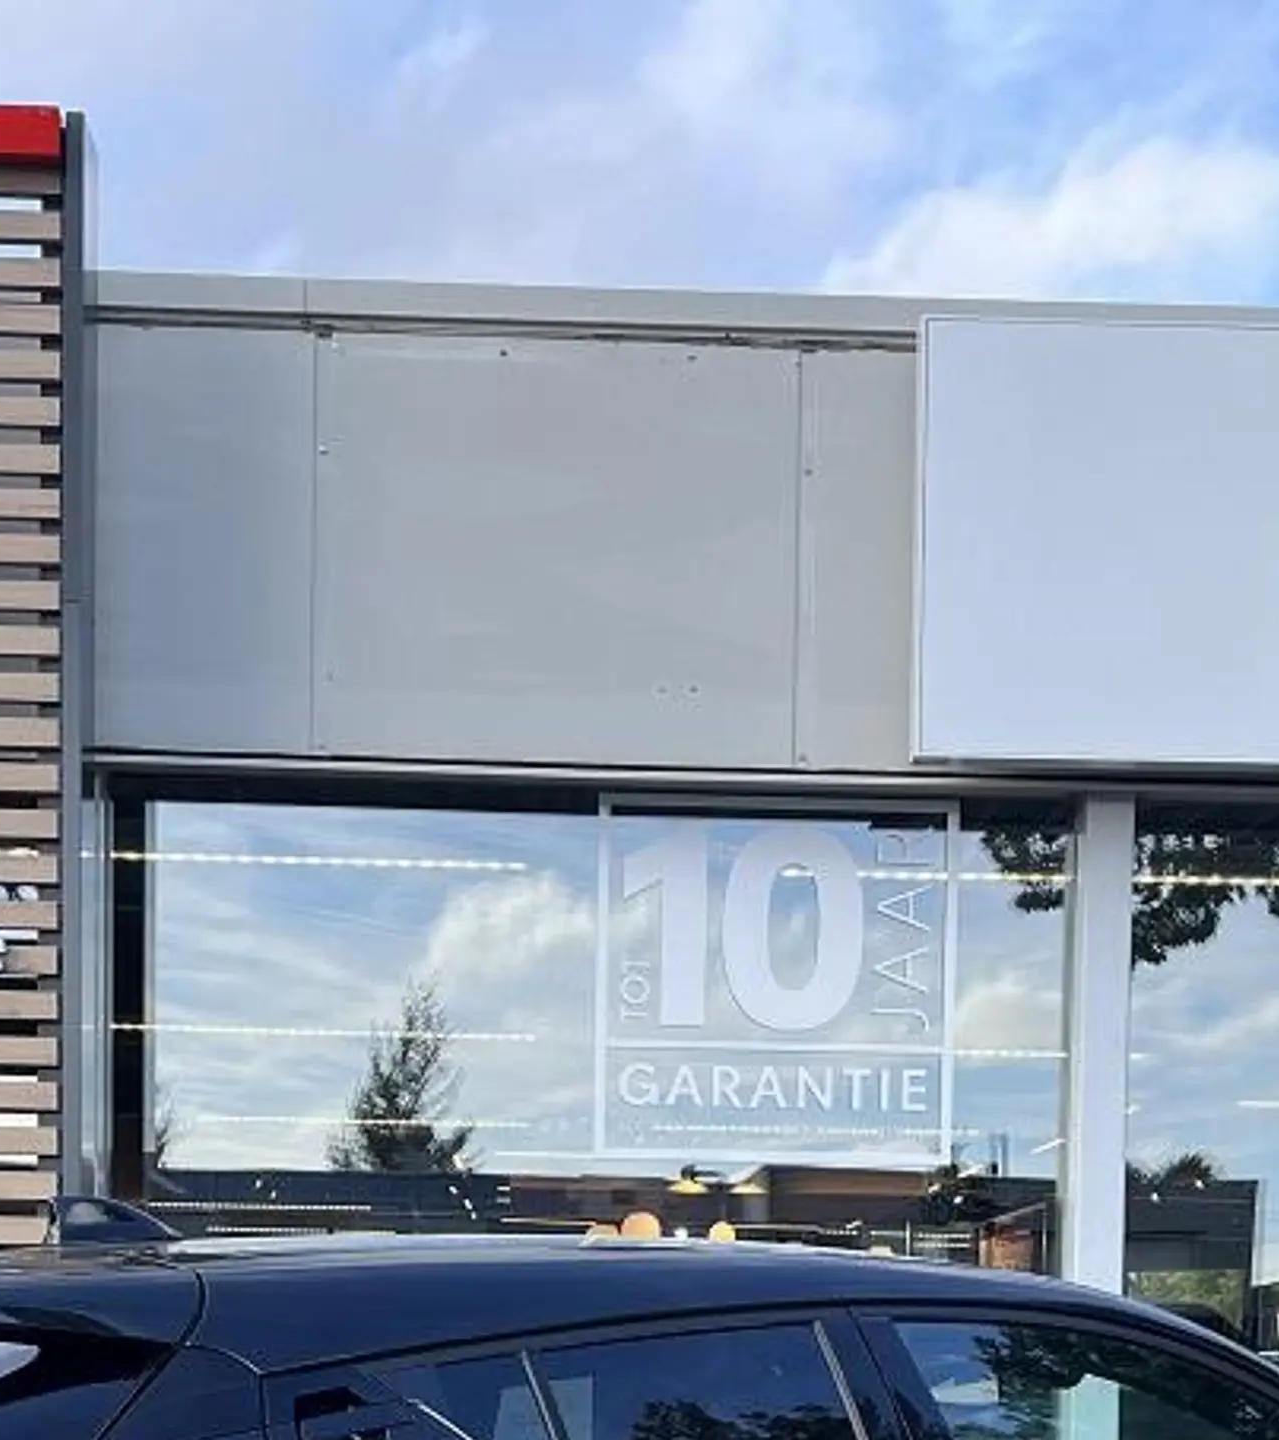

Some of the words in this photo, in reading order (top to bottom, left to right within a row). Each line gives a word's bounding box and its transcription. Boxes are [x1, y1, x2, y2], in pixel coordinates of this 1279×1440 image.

[623, 823, 865, 1032] 10
[870, 825, 934, 1033] JAAR
[618, 1061, 929, 1113] GARANTIE
